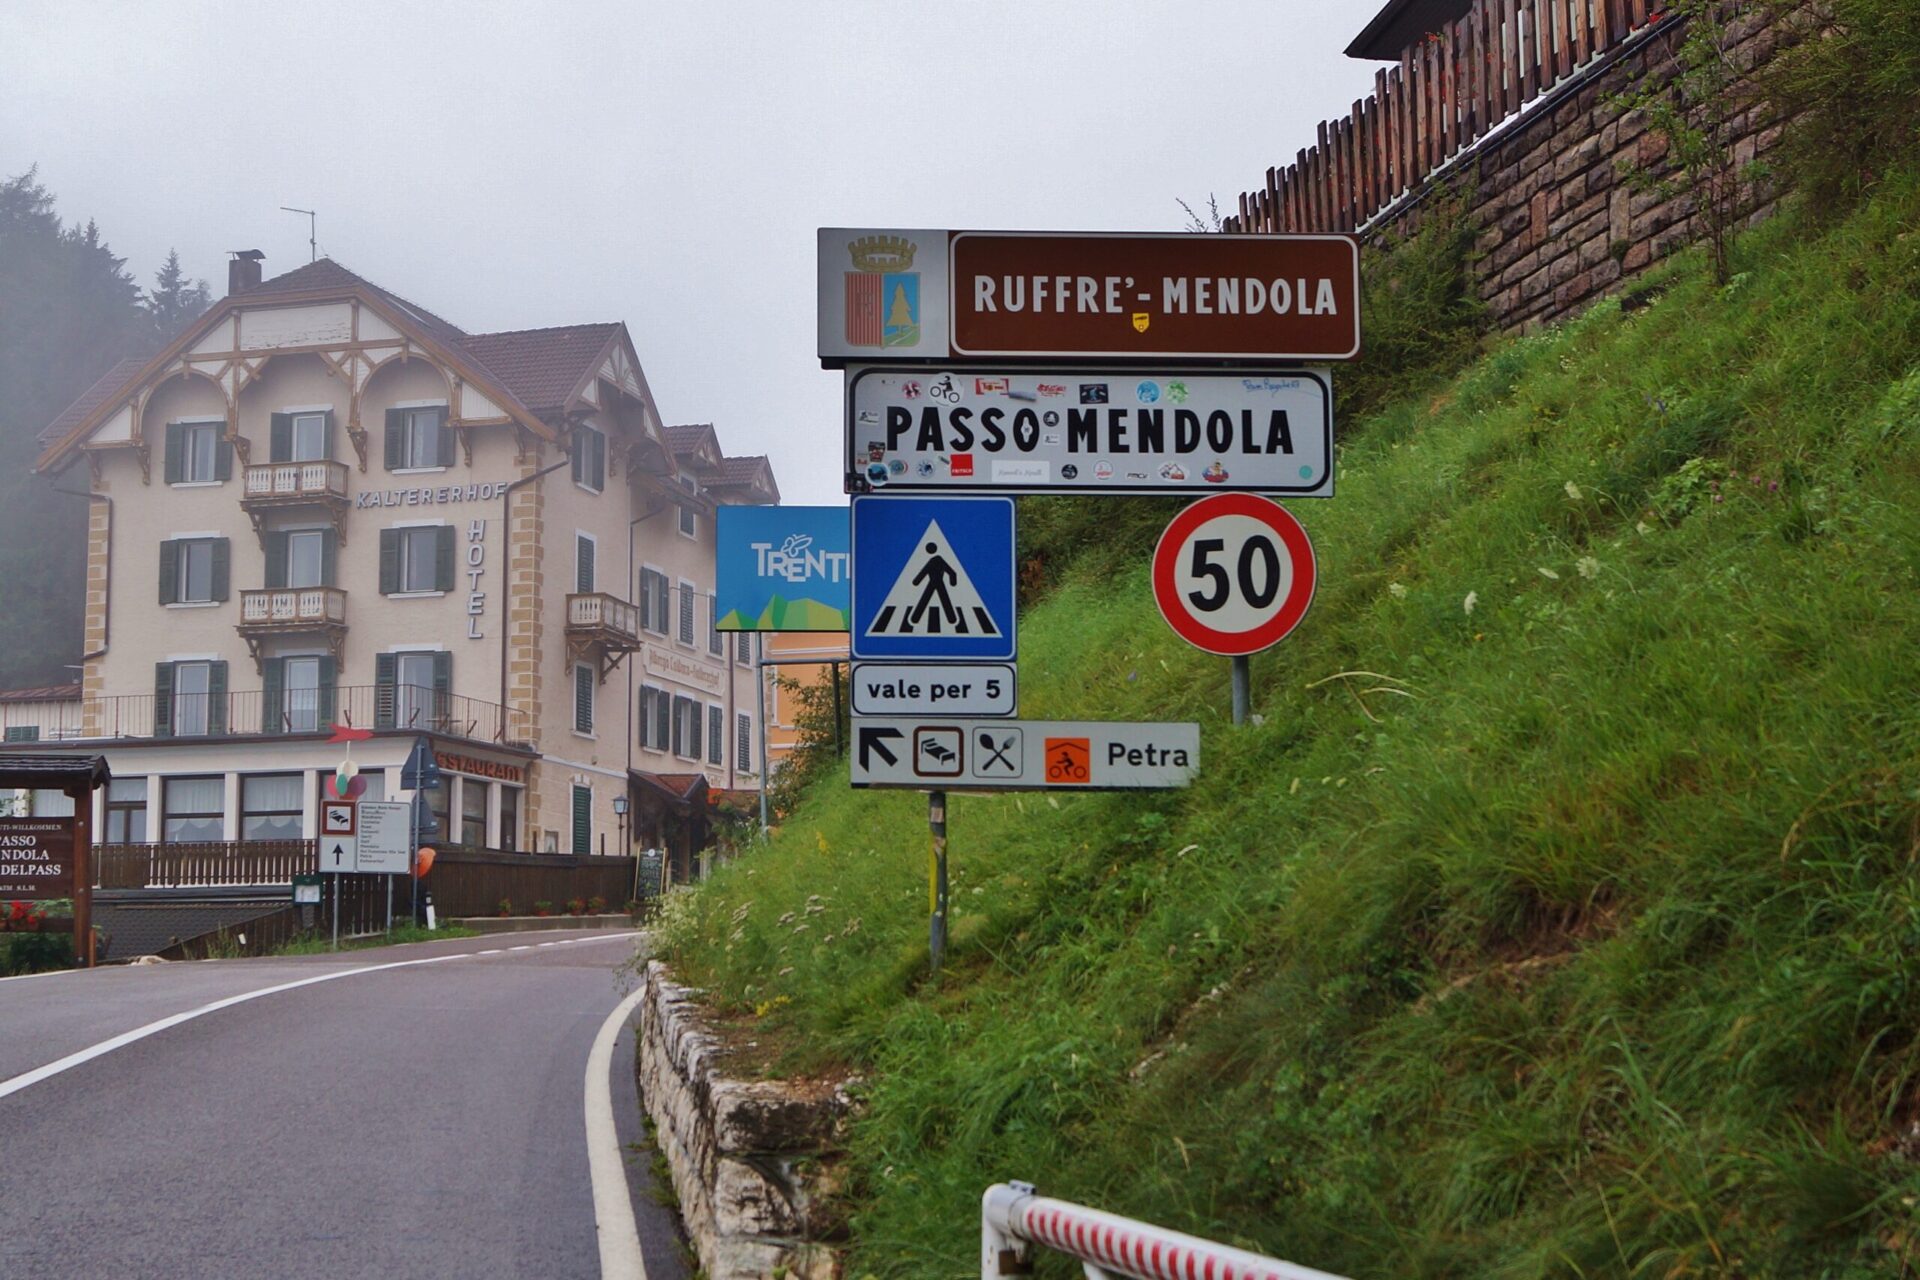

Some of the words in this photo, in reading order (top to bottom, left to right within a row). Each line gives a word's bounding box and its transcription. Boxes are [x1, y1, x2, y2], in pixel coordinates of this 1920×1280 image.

[1163, 277, 1338, 315] MENDOLA
[886, 406, 1040, 452] PASSO
[1067, 408, 1294, 455] MENDOLA
[355, 482, 508, 509] KALTERERHOF
[466, 519, 486, 640] HOTEL
[1187, 534, 1282, 613] 50
[867, 679, 920, 699] vale
[930, 683, 972, 703] per
[985, 679, 1001, 699] 5
[1107, 742, 1190, 767] Petra
[0, 836, 36, 846] ASSO
